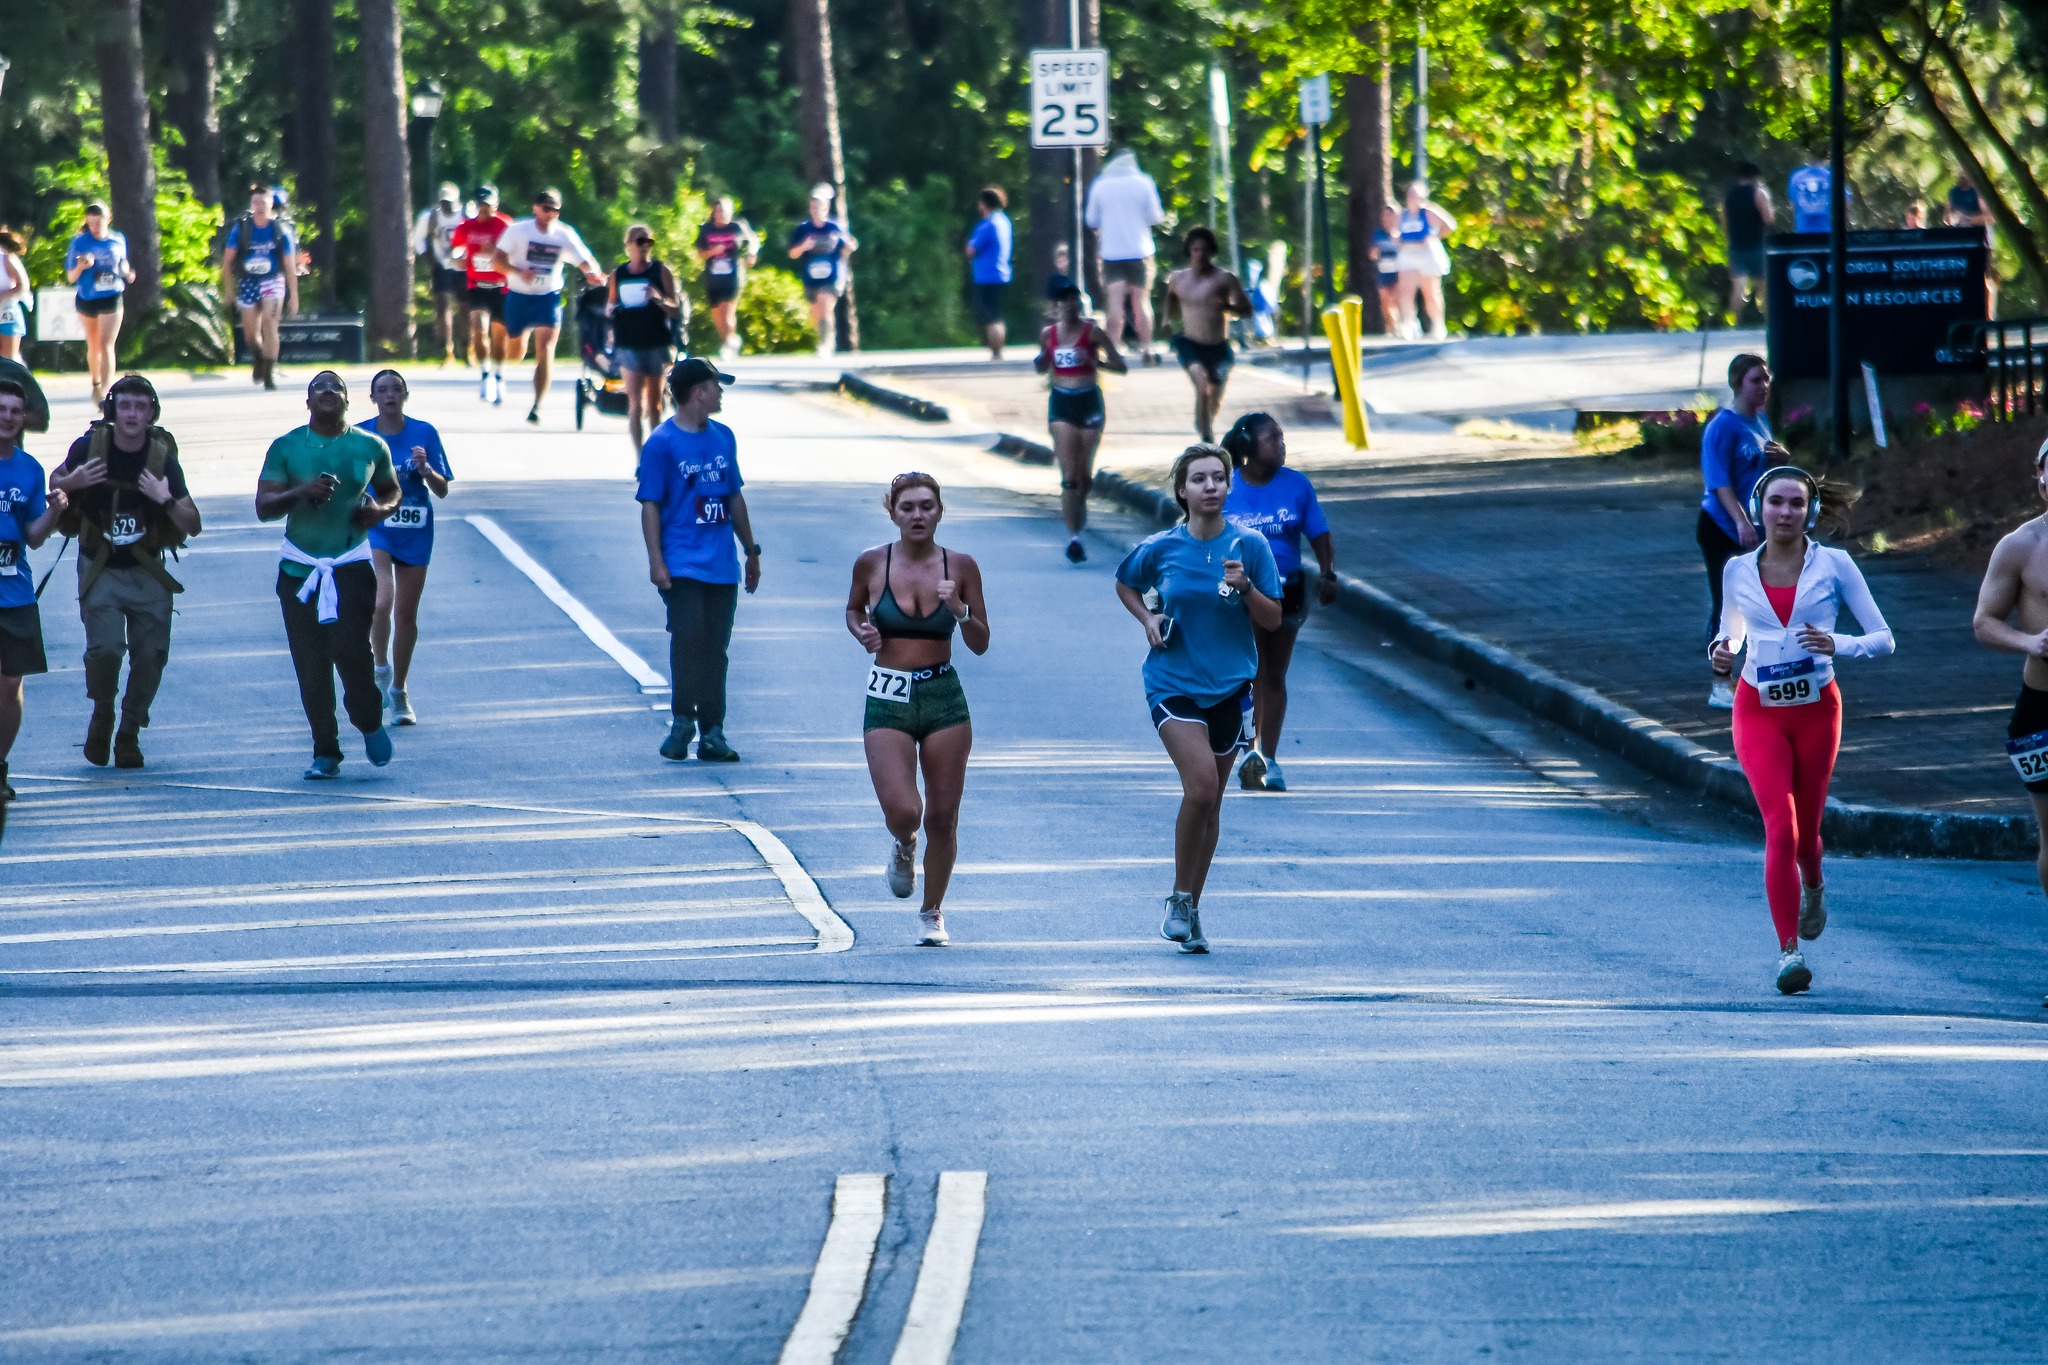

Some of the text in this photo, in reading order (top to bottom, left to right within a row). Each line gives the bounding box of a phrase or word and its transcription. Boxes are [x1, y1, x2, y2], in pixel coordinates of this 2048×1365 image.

[1039, 62, 1099, 77] SPEED
[1045, 82, 1092, 96] LIMIT
[1041, 104, 1099, 136] 25
[1826, 258, 1967, 274] ORGIA SOUTHERN
[1794, 289, 1963, 309] HUMN RESOURCES
[391, 509, 421, 524] 396
[704, 503, 725, 520] 971
[112, 518, 136, 535] 629
[868, 670, 908, 697] 272
[1768, 679, 1811, 701] 599
